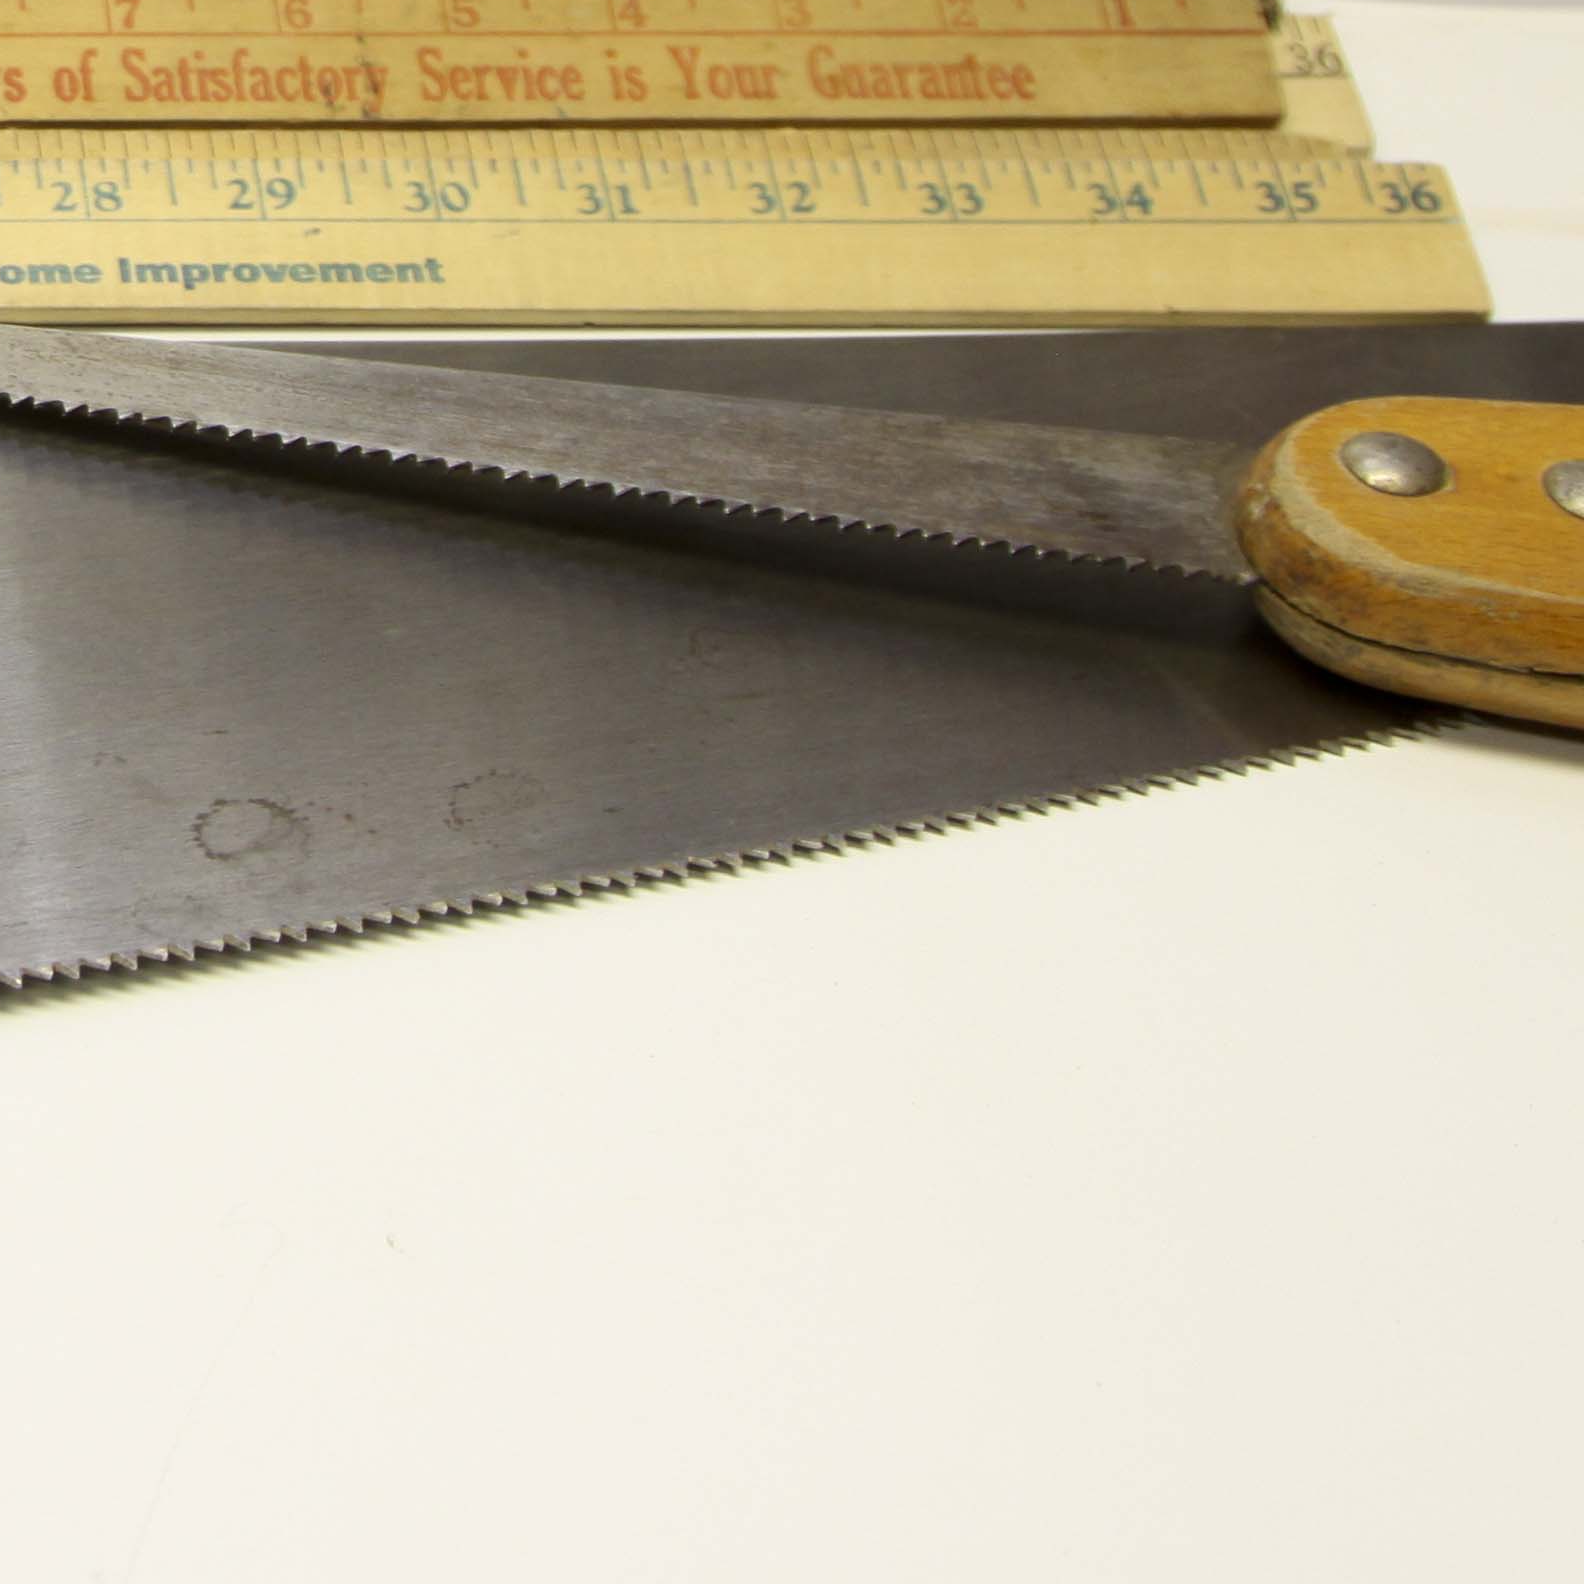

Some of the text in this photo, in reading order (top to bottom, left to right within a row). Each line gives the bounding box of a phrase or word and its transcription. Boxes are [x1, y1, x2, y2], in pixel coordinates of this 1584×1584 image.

[1289, 44, 1342, 76] 36
[53, 49, 98, 102] of
[123, 47, 387, 113] Satisfactory
[417, 46, 584, 101] Service
[607, 49, 648, 101] is
[667, 45, 781, 101] Your
[805, 44, 1035, 101] Guarantee
[52, 182, 123, 212] 28
[229, 179, 297, 210] 29
[404, 180, 471, 212] 30
[577, 183, 638, 214] 31
[750, 182, 816, 213] 32
[919, 183, 984, 214] 33
[1087, 183, 1154, 214] 34
[1258, 181, 1317, 212] 35
[1380, 181, 1439, 212] 36
[118, 257, 445, 288] Improvement
